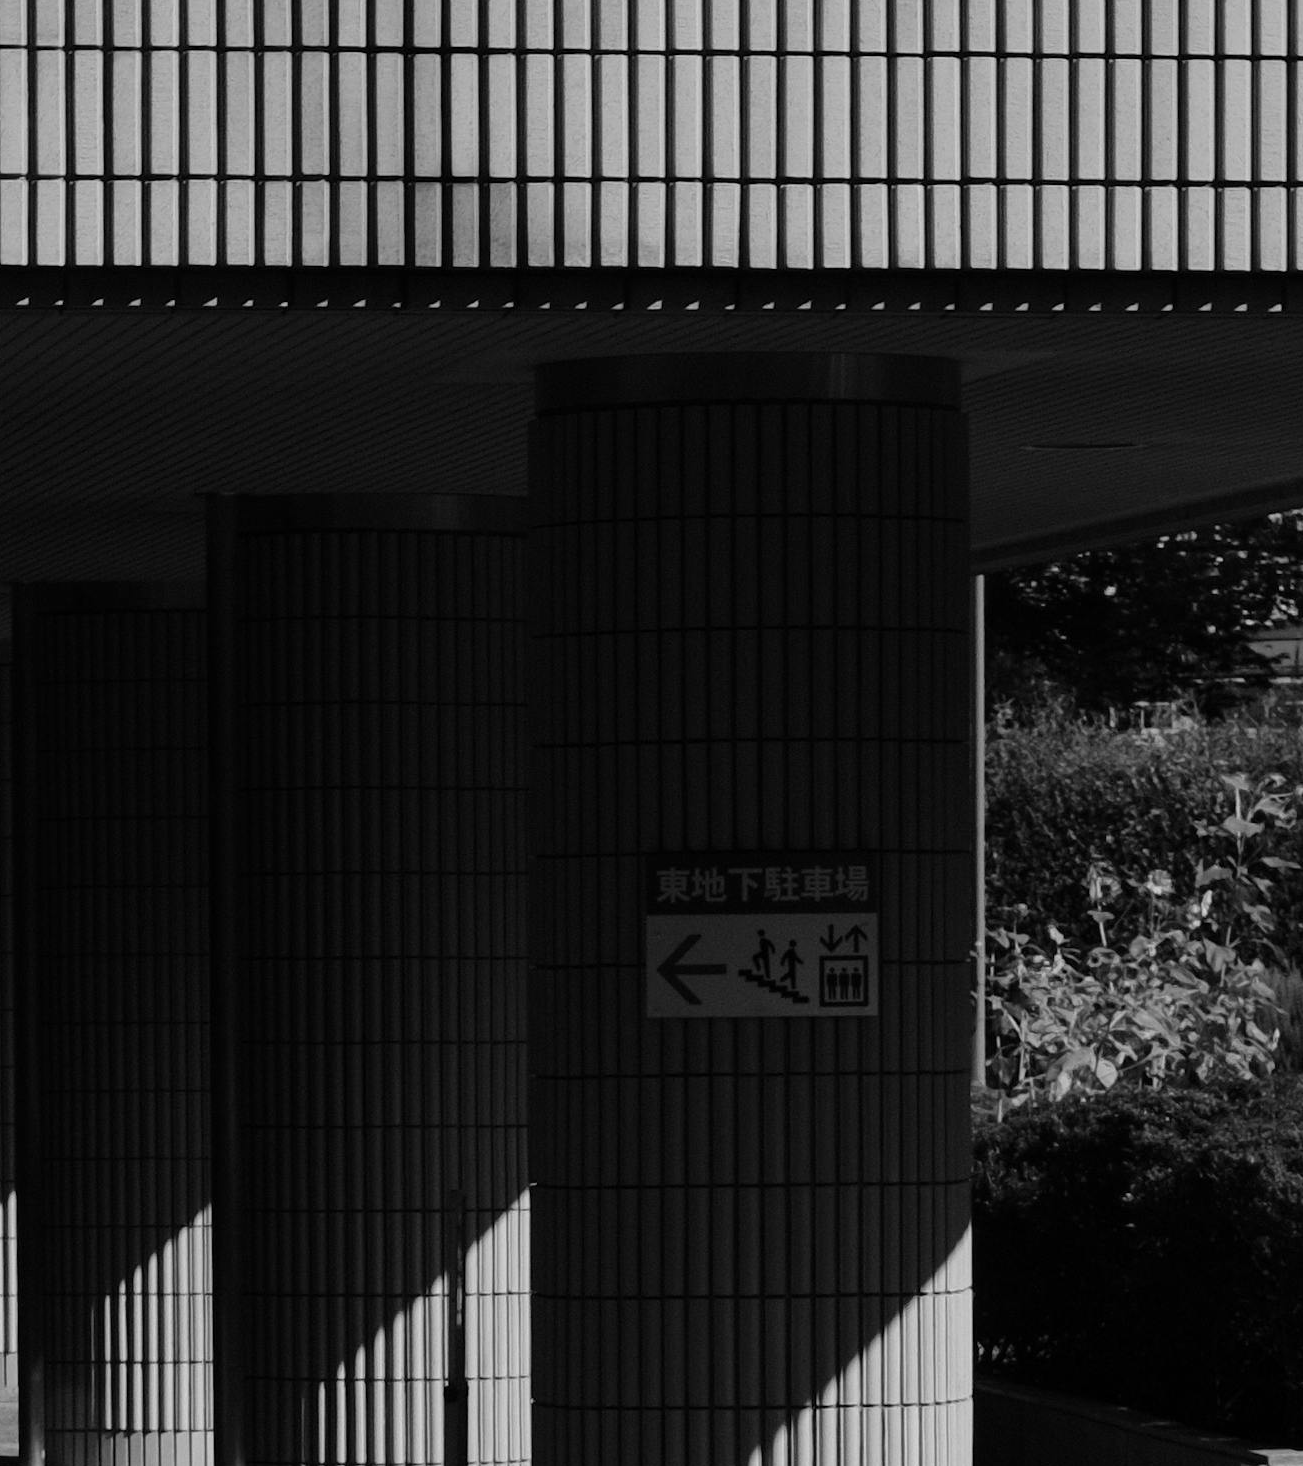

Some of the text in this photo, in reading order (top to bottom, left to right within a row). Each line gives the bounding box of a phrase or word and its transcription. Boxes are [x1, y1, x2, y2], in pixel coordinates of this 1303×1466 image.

[656, 866, 870, 902] 東地下駐車場
